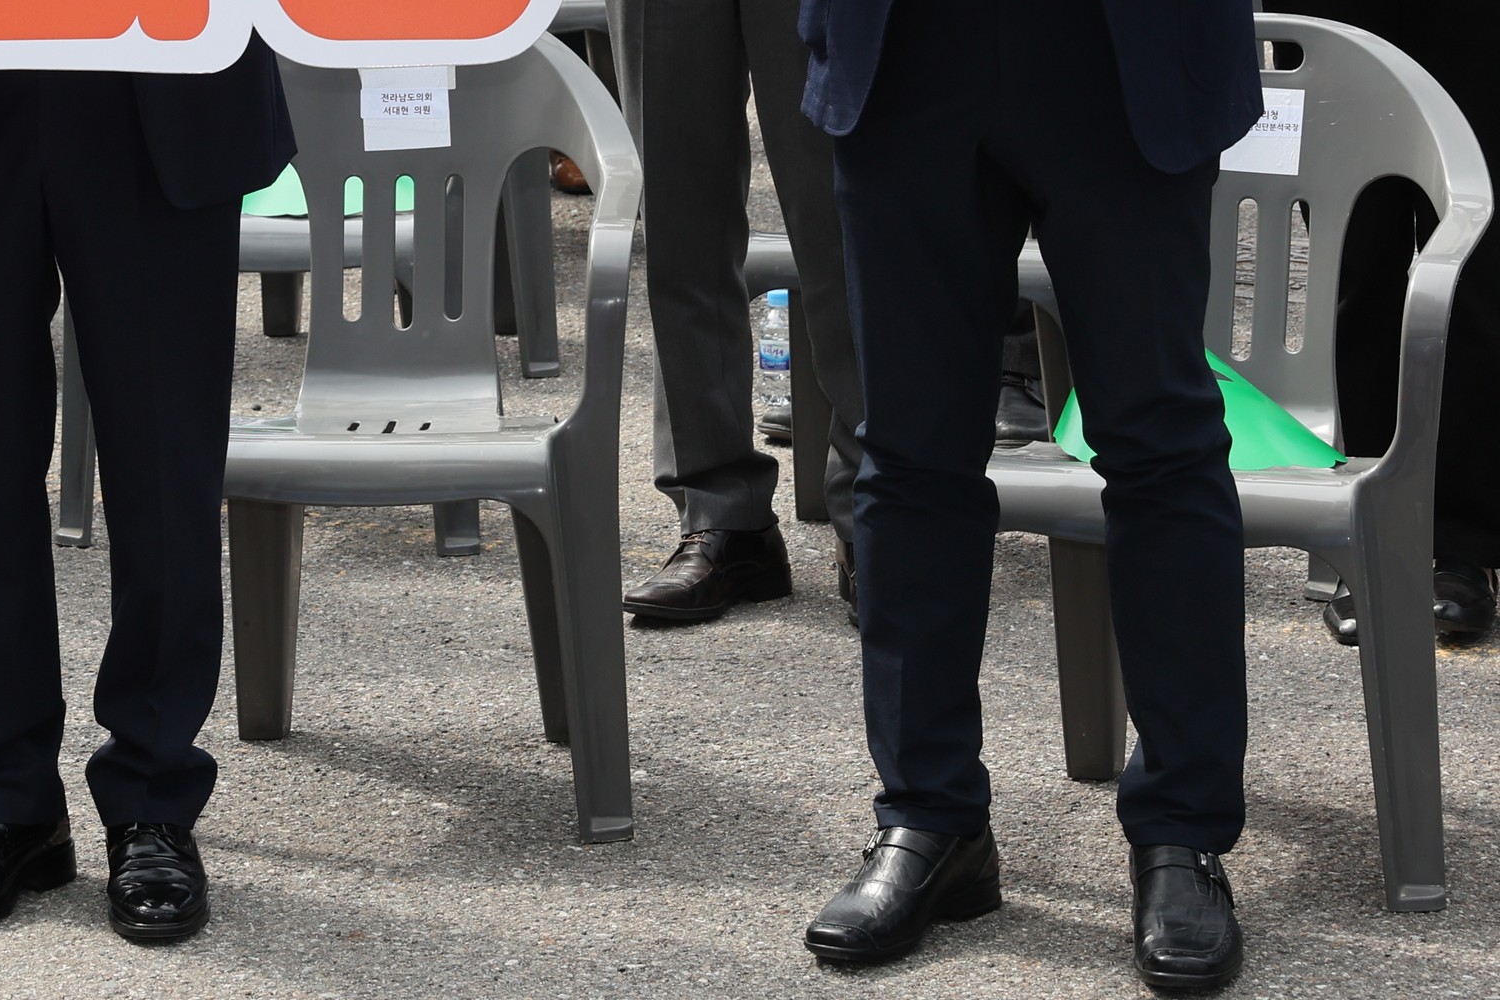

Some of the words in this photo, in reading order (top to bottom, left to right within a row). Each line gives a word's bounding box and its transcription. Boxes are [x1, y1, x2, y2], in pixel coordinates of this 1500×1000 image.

[381, 92, 433, 102] 전라남도의회
[414, 105, 431, 115] 의원
[1250, 122, 1299, 132] 진단분석국장
